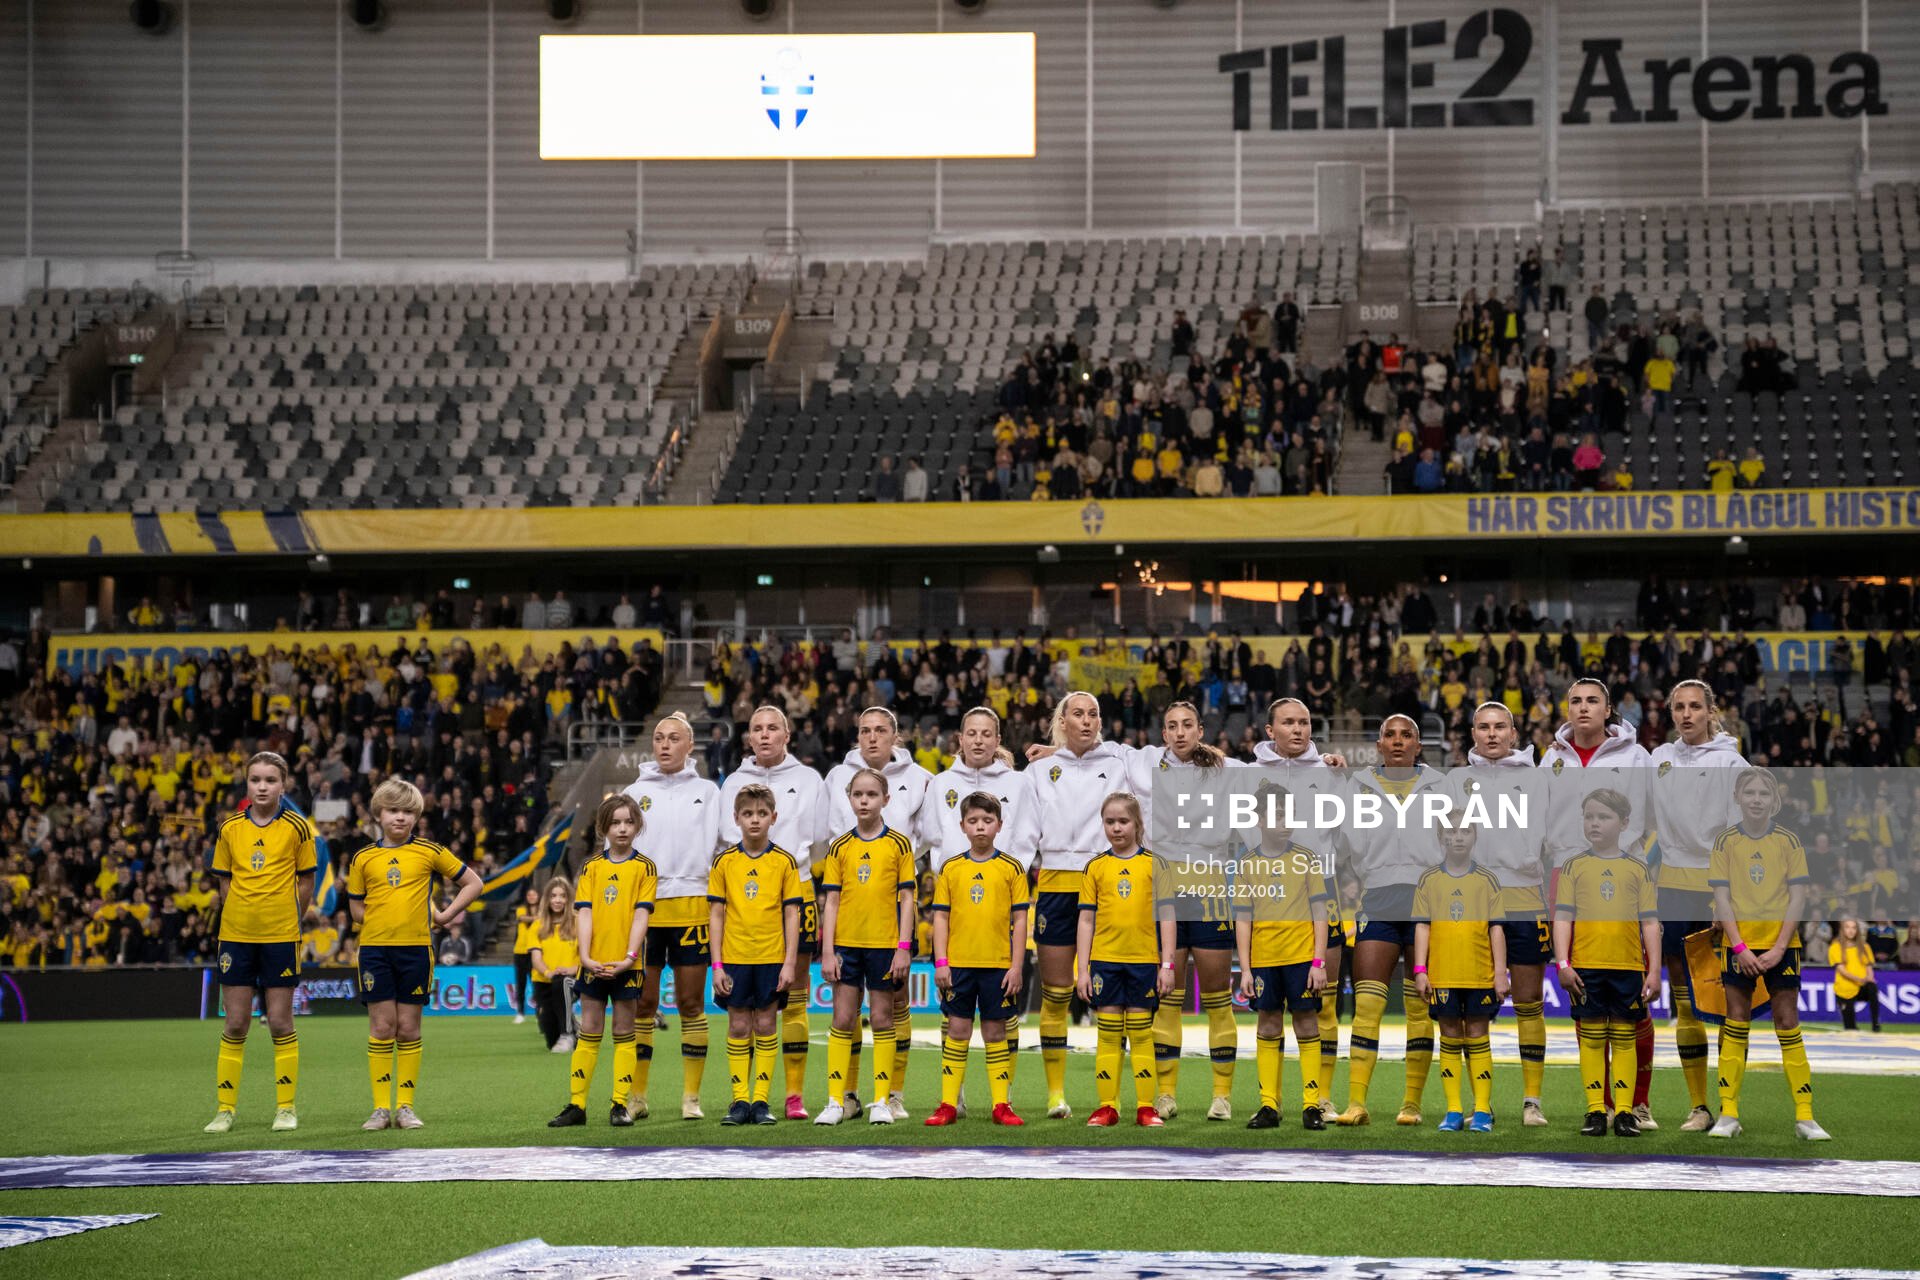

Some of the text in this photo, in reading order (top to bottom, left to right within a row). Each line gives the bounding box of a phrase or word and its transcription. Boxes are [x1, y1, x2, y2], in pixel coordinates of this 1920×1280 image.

[1219, 8, 1889, 131] TELE2 Arena
[1360, 304, 1399, 320] B308
[735, 319, 771, 334] B309
[1467, 495, 1538, 532] HÄR
[1546, 494, 1674, 532] SKRIVS
[1682, 491, 1817, 530] BLÅGUL
[616, 752, 656, 768] A10
[1201, 897, 1228, 922] 10
[1536, 913, 1550, 942] 5
